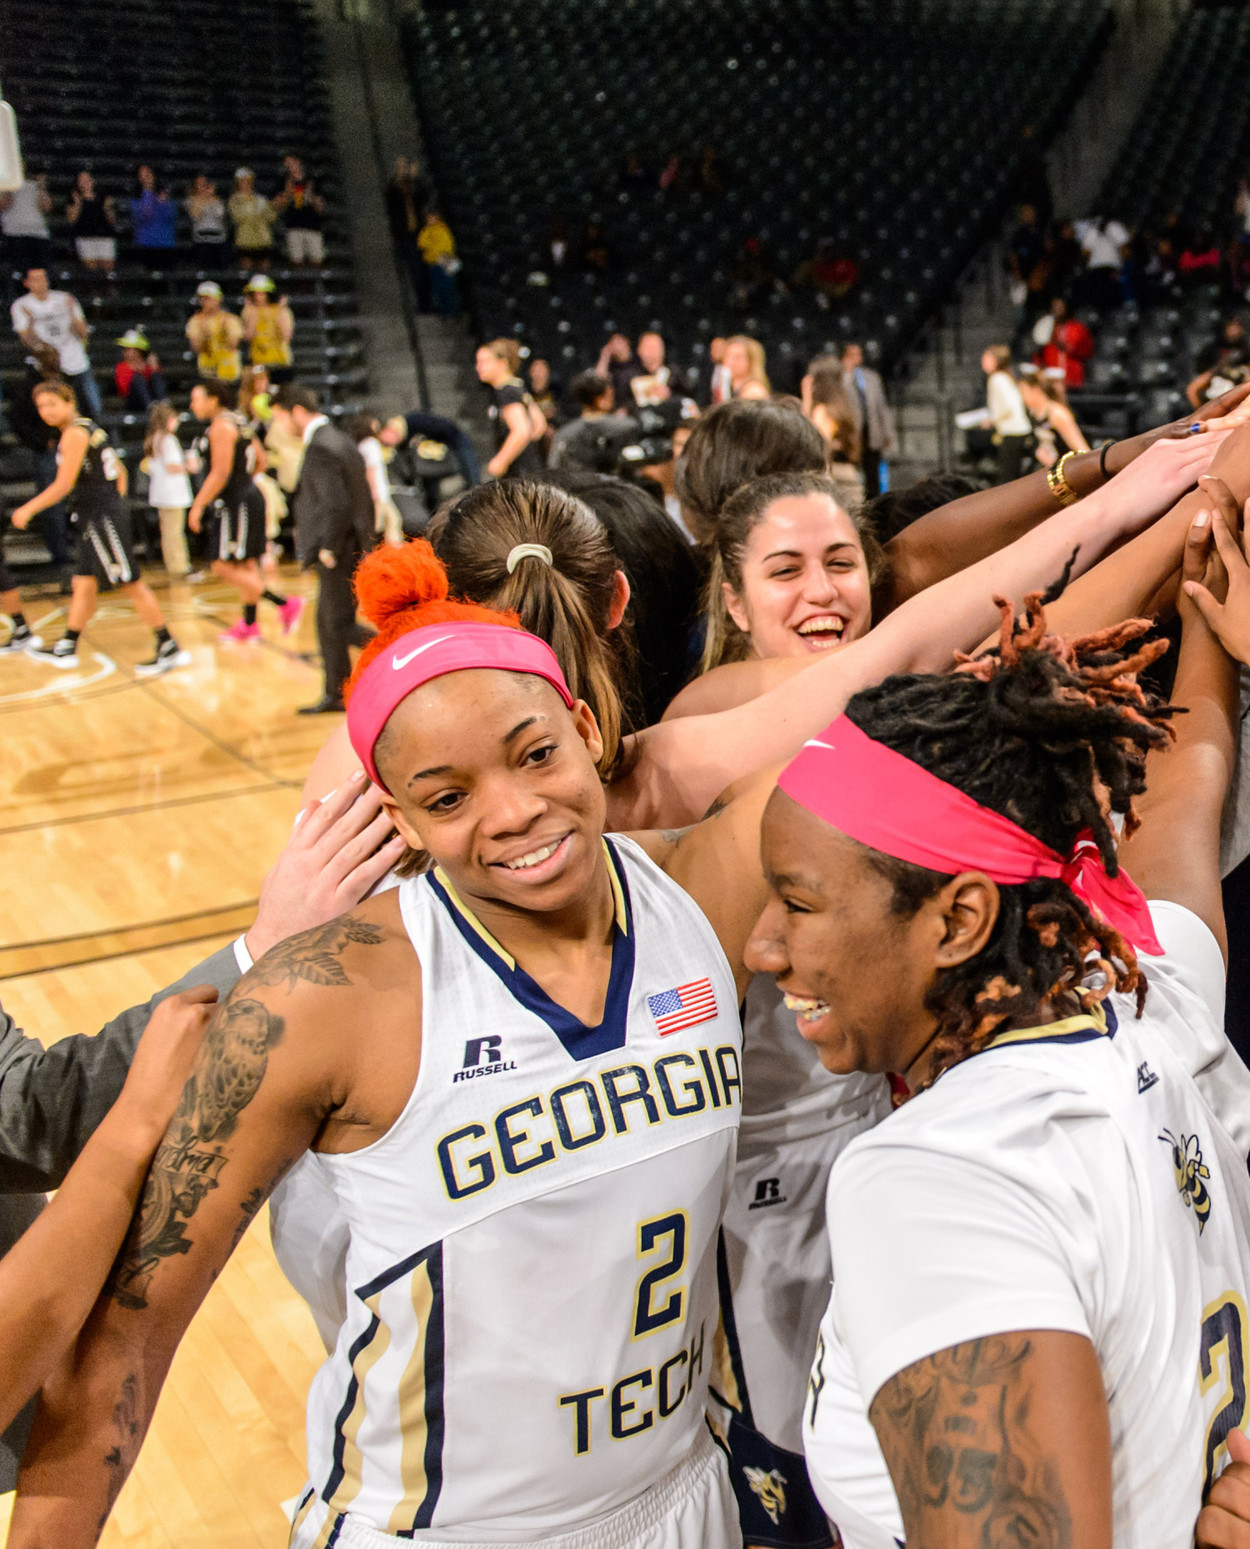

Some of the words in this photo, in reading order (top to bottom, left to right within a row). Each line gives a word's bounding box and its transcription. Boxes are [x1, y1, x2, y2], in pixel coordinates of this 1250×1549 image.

[452, 1060, 518, 1083] RUSSELL
[462, 1034, 502, 1069] R
[436, 1044, 743, 1202] GEORGIA
[629, 1207, 690, 1343] 2
[557, 1318, 706, 1458] TECH
